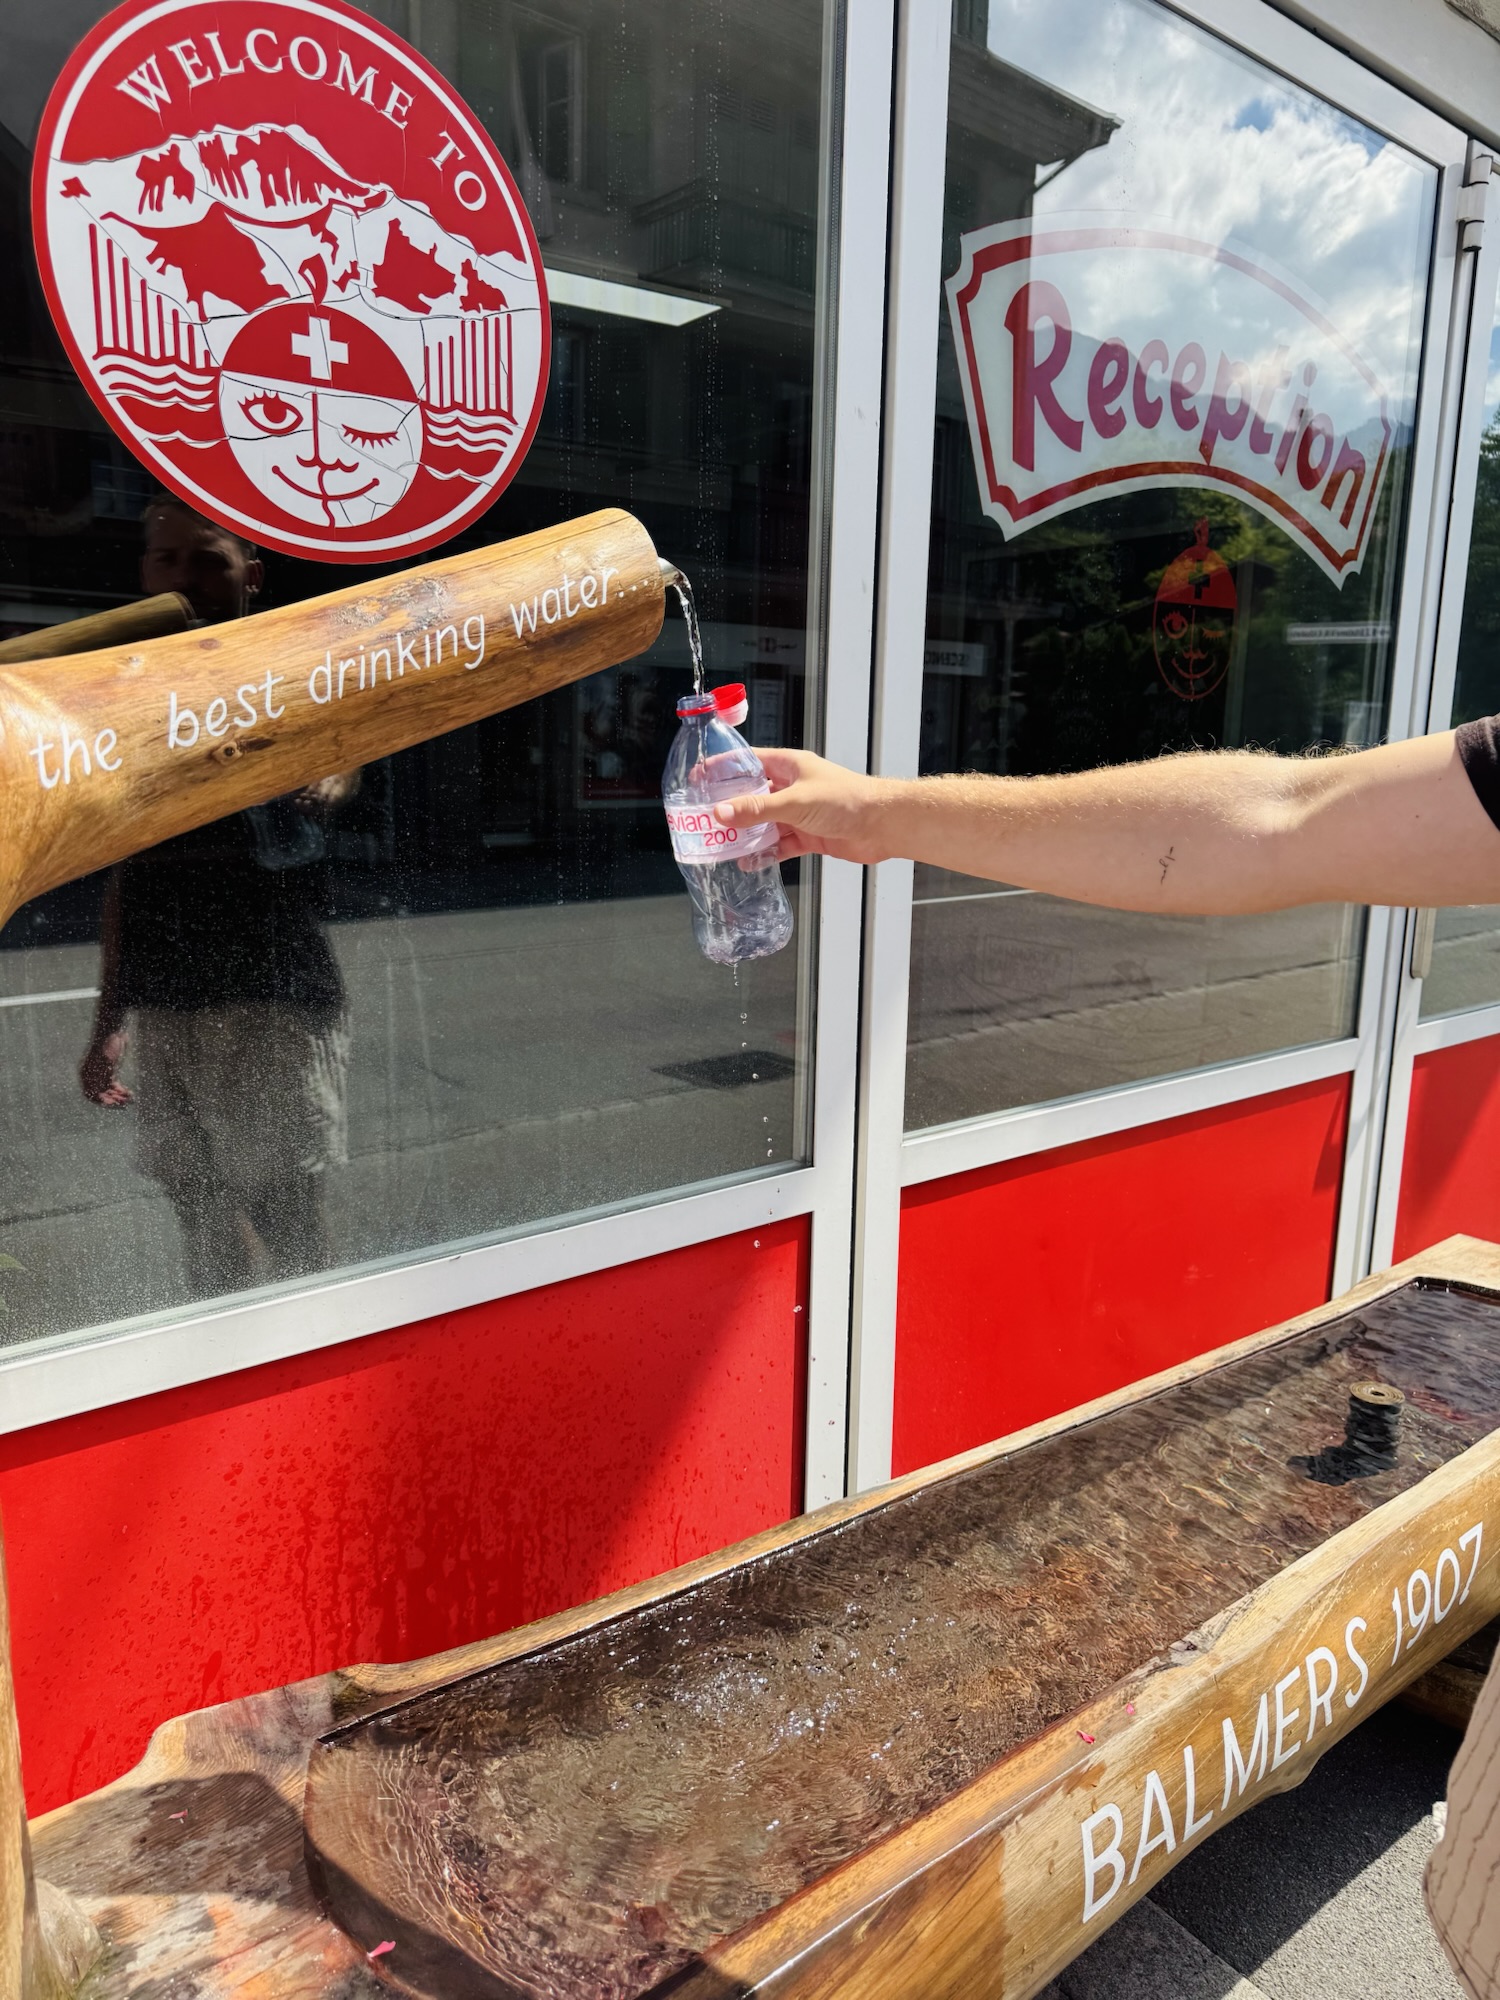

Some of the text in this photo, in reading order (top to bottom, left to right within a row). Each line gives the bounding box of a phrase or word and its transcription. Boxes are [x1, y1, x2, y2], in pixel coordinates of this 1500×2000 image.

[115, 27, 487, 211] WELCOME TO
[1004, 280, 1366, 530] Reception
[29, 723, 123, 789] the
[168, 670, 285, 749] best
[308, 613, 486, 704] drinking
[703, 827, 738, 847] 200
[1081, 1521, 1483, 1924] BALMERS 1907
